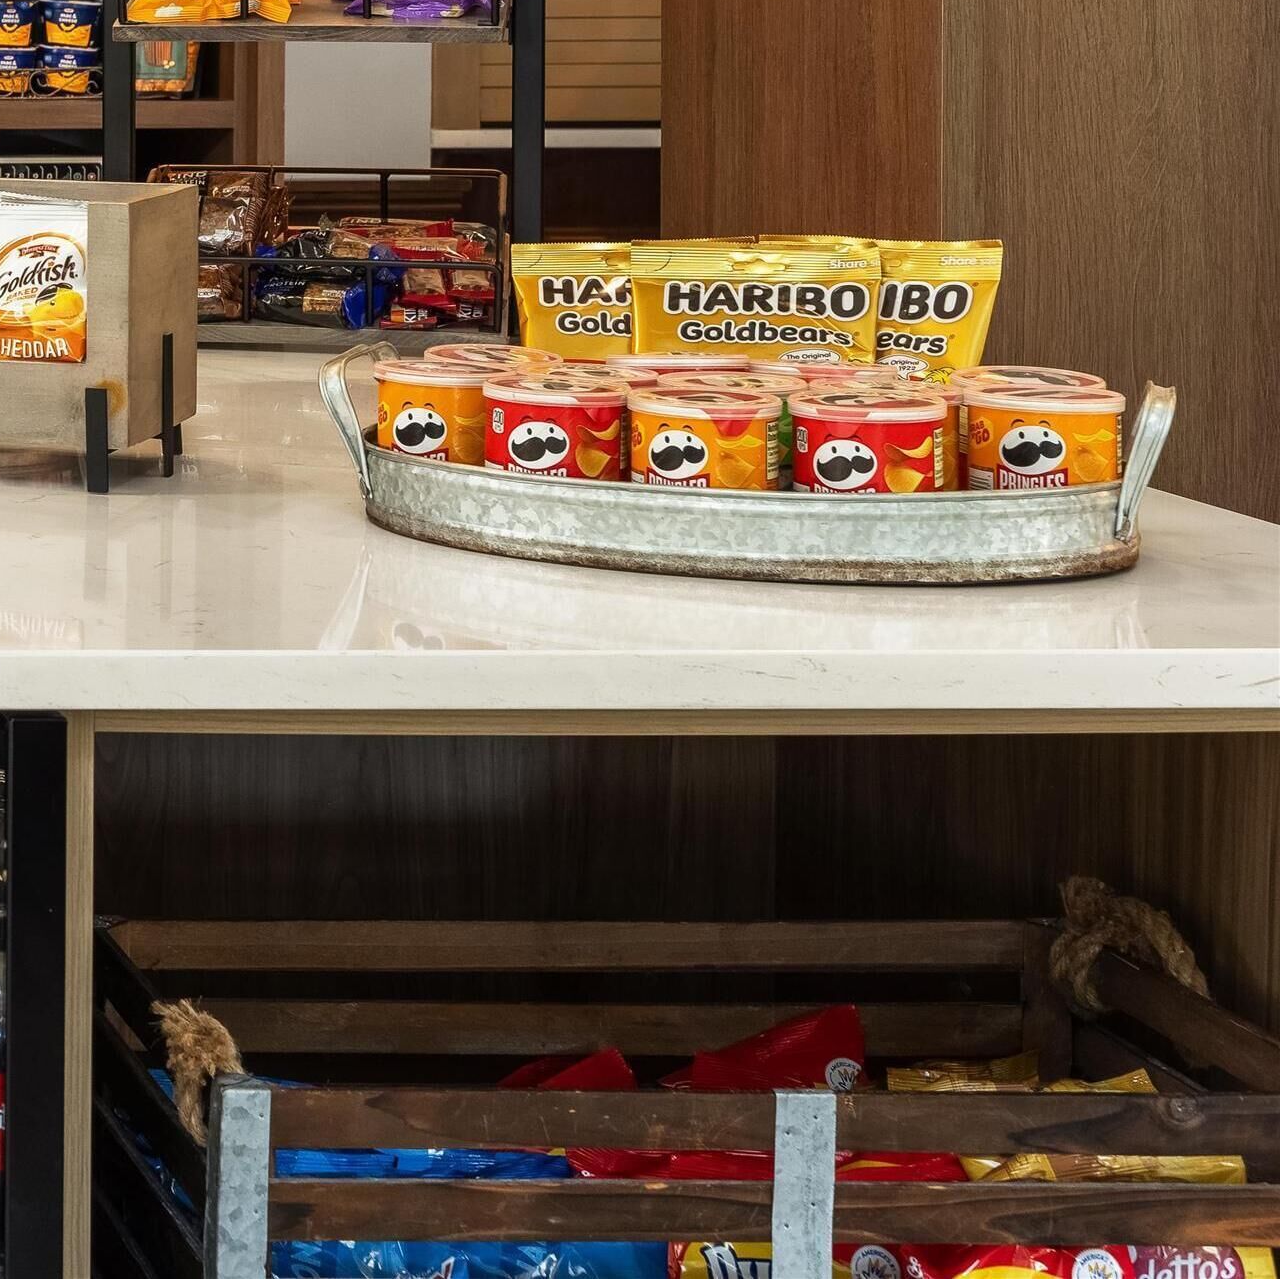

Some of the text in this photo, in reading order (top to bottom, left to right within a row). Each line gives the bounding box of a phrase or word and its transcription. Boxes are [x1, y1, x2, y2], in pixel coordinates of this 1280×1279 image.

[830, 259, 868, 269] Share
[940, 256, 978, 267] Share
[667, 282, 868, 319] HARIBO
[679, 320, 854, 346] Goldbears
[785, 352, 832, 363] The Original
[892, 357, 923, 366] Original
[999, 470, 1066, 491] PRINGLES
